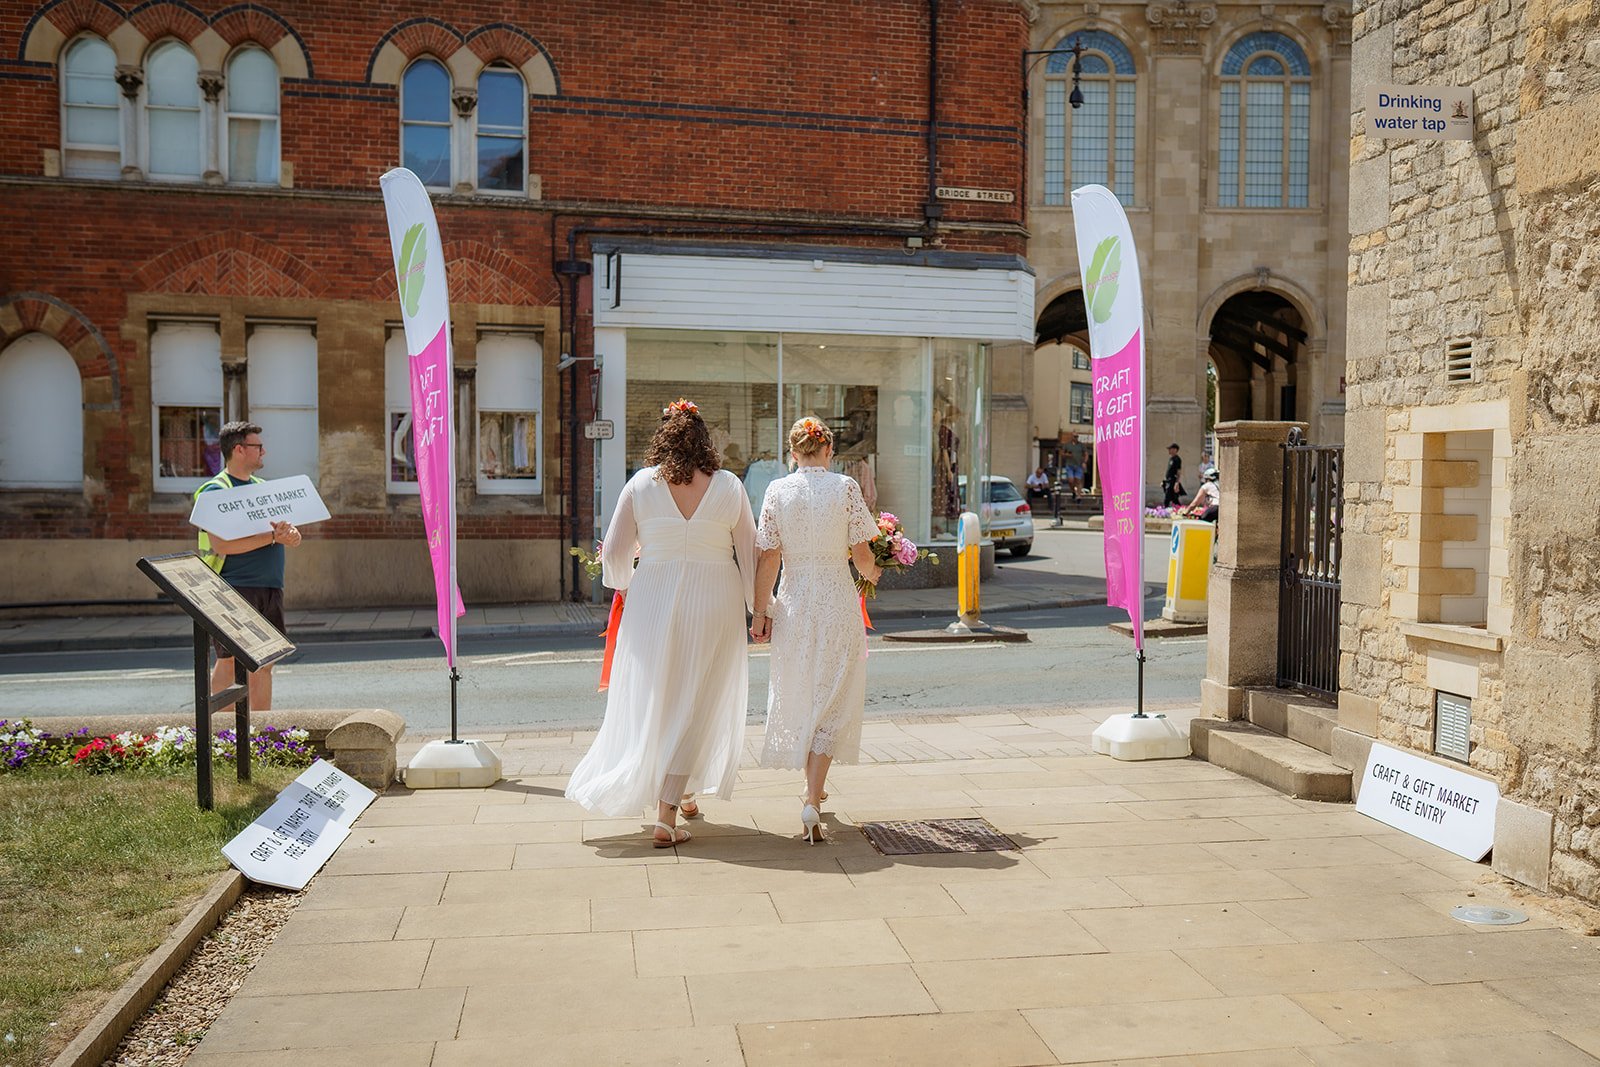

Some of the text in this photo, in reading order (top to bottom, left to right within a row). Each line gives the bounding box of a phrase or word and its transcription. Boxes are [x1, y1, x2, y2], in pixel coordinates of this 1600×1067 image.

[1379, 94, 1442, 112] Drinking
[1375, 116, 1446, 133] water tap
[938, 189, 1011, 200] BRIDGE STREET
[1095, 367, 1130, 395] CRAFT
[1096, 391, 1133, 419] & GIFT
[1097, 415, 1137, 444] MARKET
[217, 488, 308, 513] CRAFT & GIFT MARKET
[246, 504, 293, 521] FREE ENTRY
[315, 783, 331, 796] GIFT
[322, 771, 343, 789] MARKET
[1372, 763, 1479, 815] CRAFT & GIFT MARKET
[323, 798, 341, 811] FREE
[1390, 790, 1446, 825] FREE ENTRY
[250, 807, 311, 862] CRAFT & GIFT MARKET
[283, 828, 320, 861] FREE ENTRY
